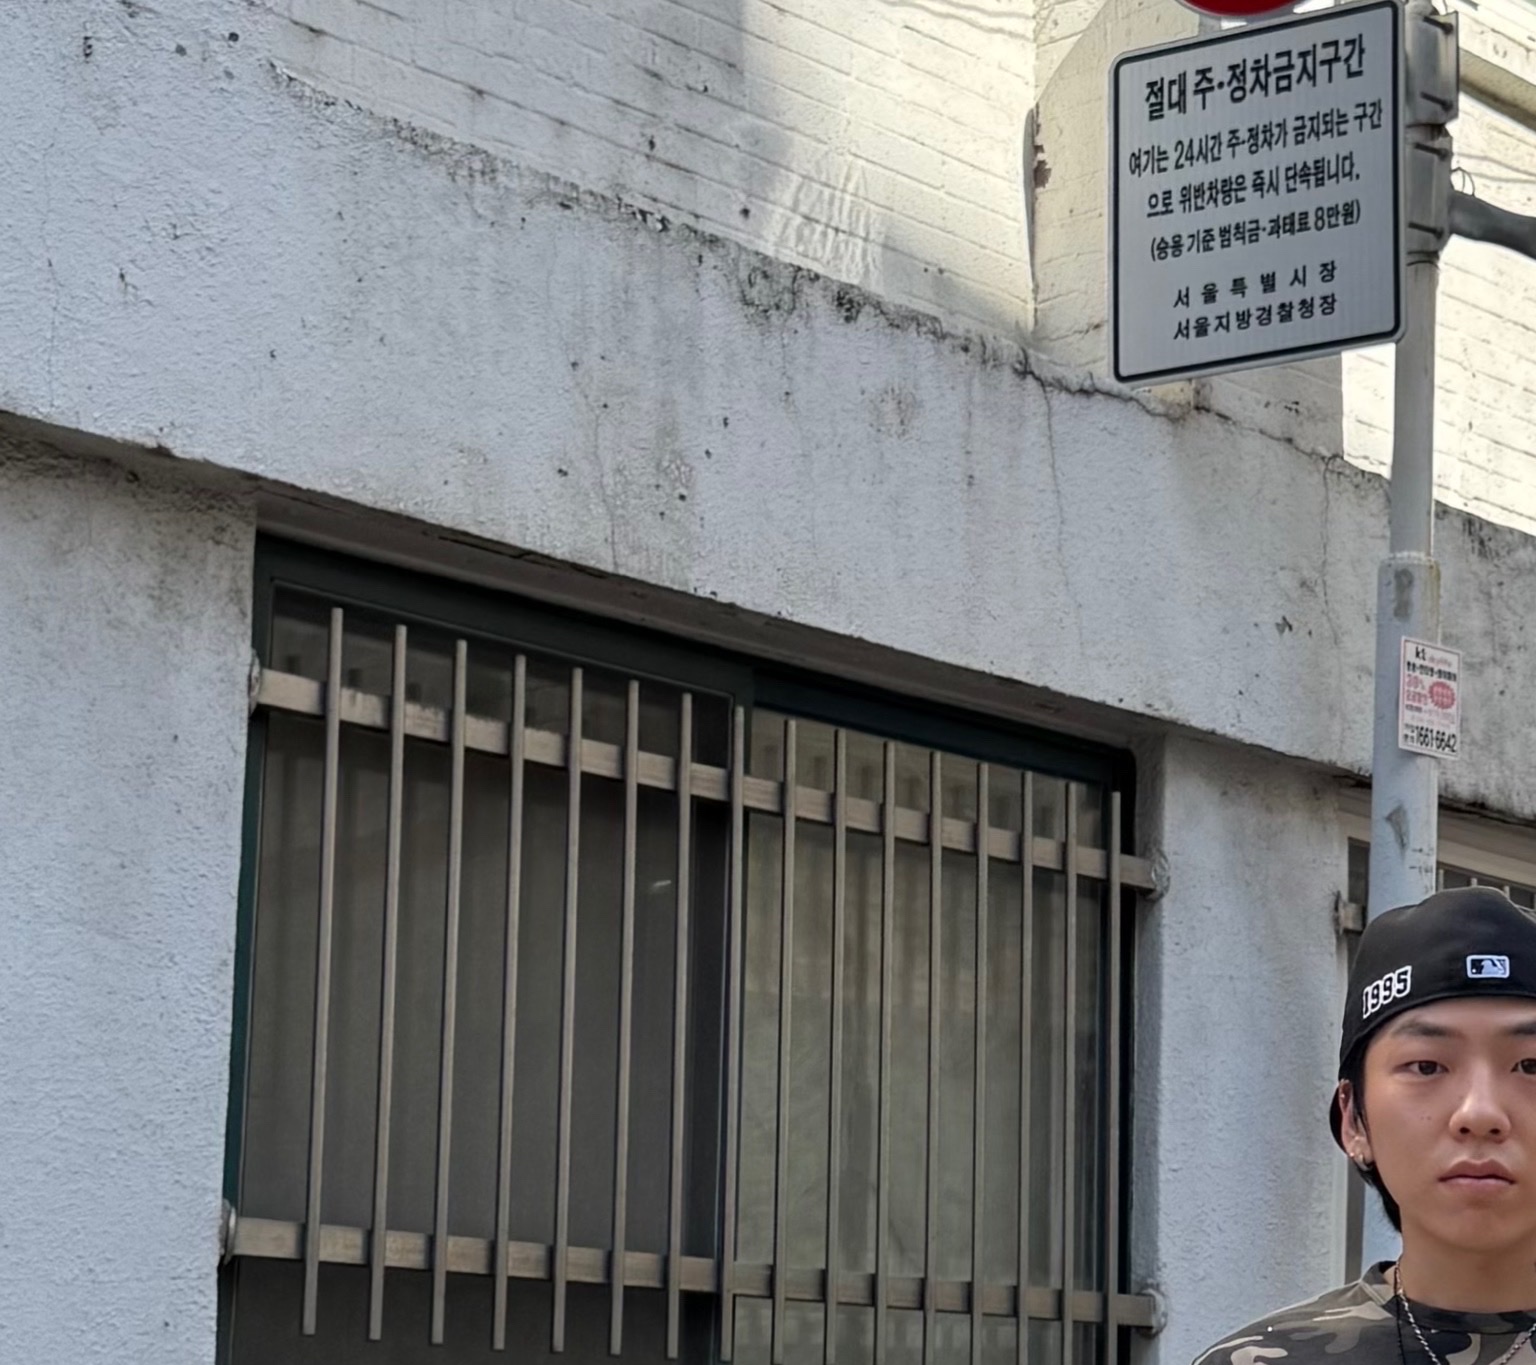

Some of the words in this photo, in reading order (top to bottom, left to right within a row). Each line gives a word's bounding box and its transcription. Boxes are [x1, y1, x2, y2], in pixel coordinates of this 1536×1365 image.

[1145, 70, 1188, 122] 절대
[1193, 33, 1366, 111] 주·정차금지구간
[1128, 145, 1170, 178] 여기는
[1173, 131, 1223, 171] 24시간
[1293, 107, 1350, 147] 금지되는
[1353, 98, 1383, 133] 구간
[1146, 189, 1174, 218] 으로
[1178, 173, 1248, 215] 위반차량은
[1251, 166, 1281, 199] 즉시
[1284, 150, 1361, 194] 단속됩니다.
[1150, 236, 1185, 262] (승용
[1186, 227, 1216, 254] 기준
[1313, 198, 1362, 232] 8만원)
[1173, 292, 1338, 341] 서울지방경찰청장
[1362, 964, 1413, 1020] 1995
